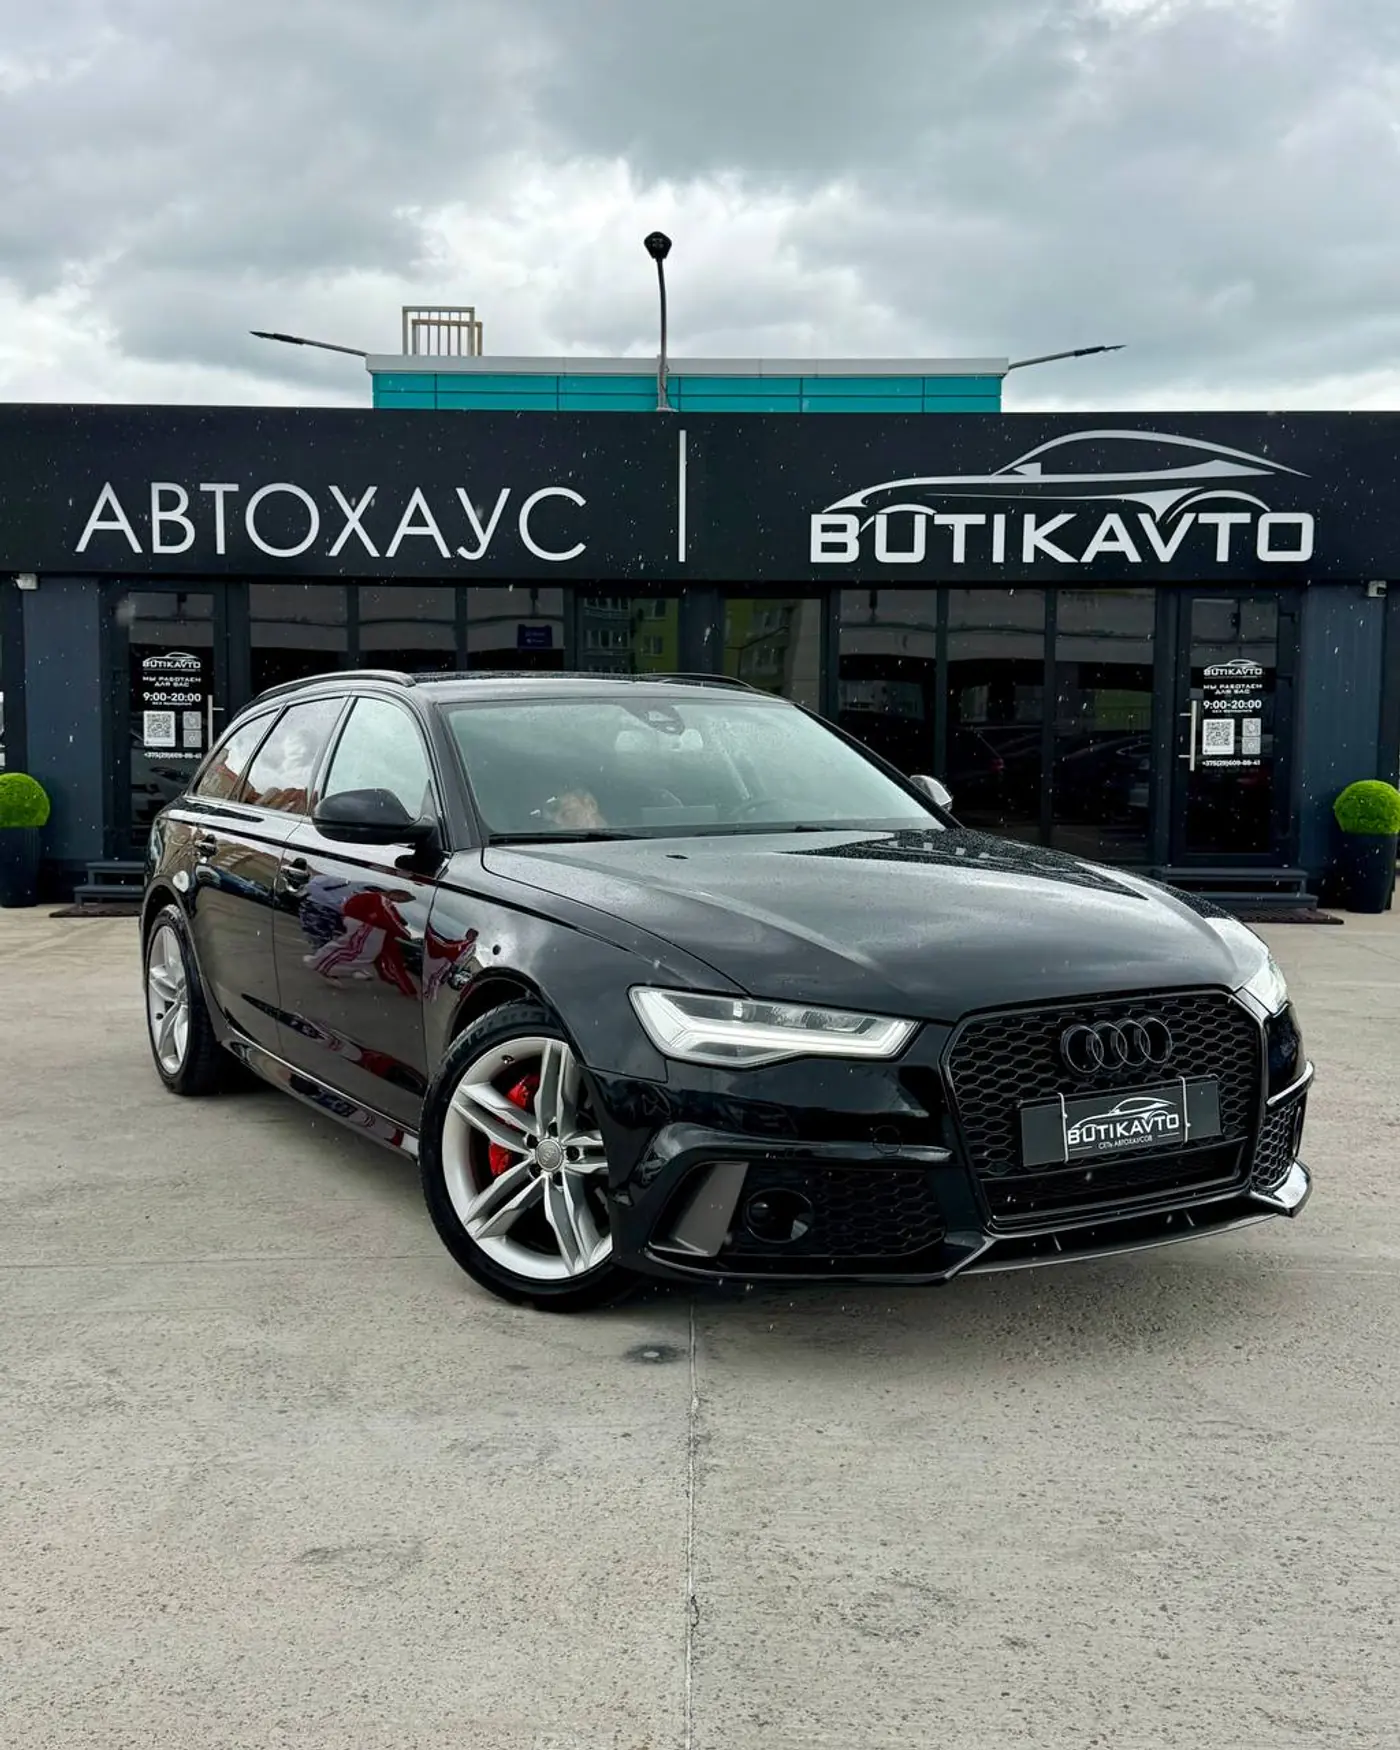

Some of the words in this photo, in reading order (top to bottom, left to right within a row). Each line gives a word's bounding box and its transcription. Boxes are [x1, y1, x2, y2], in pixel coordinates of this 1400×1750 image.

[75, 482, 587, 562] АВТОХАУС
[810, 511, 1314, 563] BUTIKAVTO
[142, 660, 201, 668] BUTIKAVTO
[1203, 668, 1262, 676] BUTIKAVTO
[143, 692, 202, 702] 9:00-20:00
[1204, 700, 1262, 710] 9:00-20:00
[1067, 1114, 1180, 1145] BUTIKAVTO
